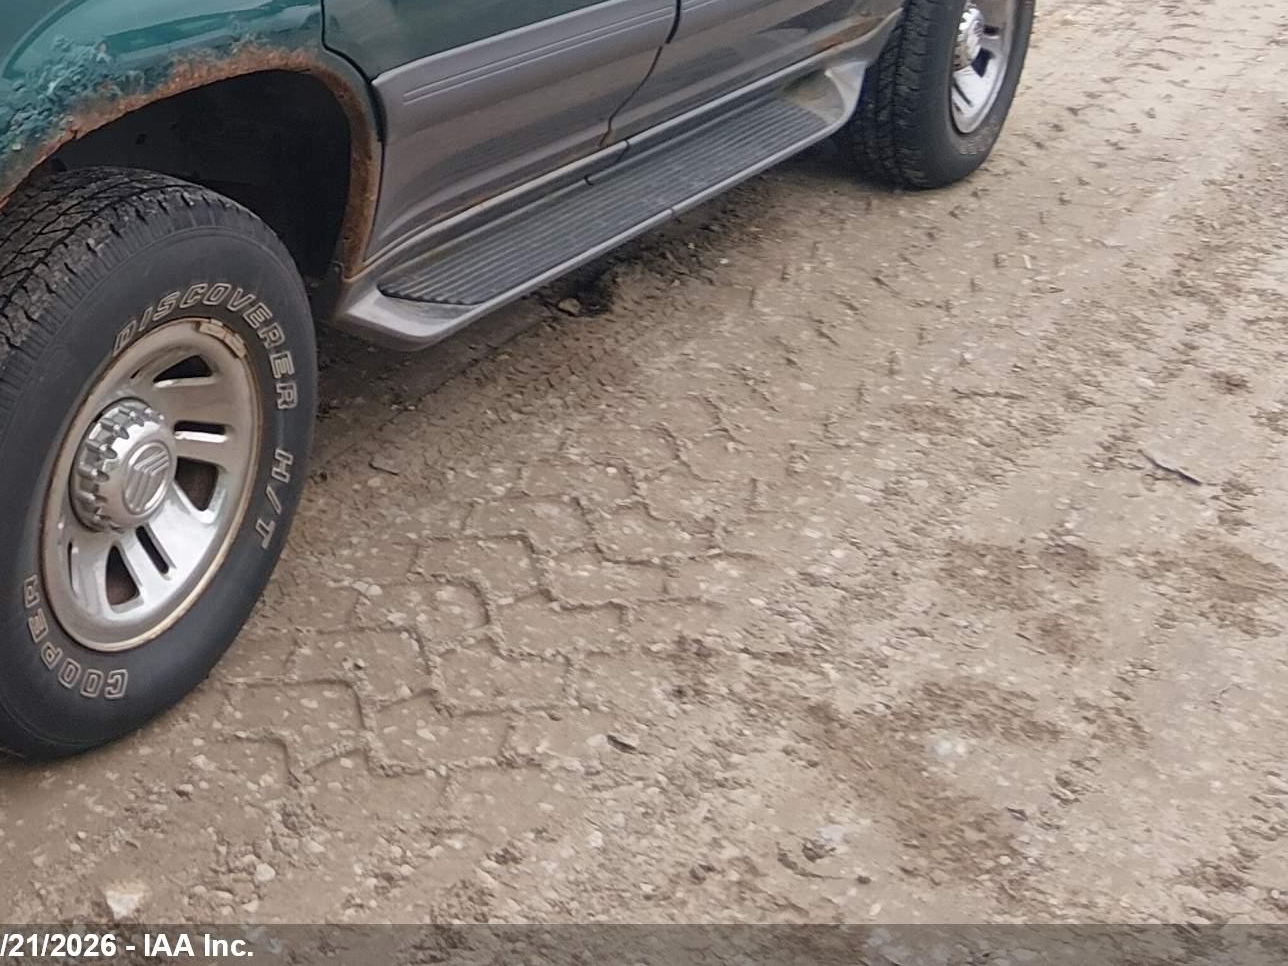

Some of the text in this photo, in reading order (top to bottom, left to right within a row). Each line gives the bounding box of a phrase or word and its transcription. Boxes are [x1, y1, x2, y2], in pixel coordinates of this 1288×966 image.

[112, 282, 298, 550] DISCOVERER H/T
[23, 574, 128, 700] COOPER
